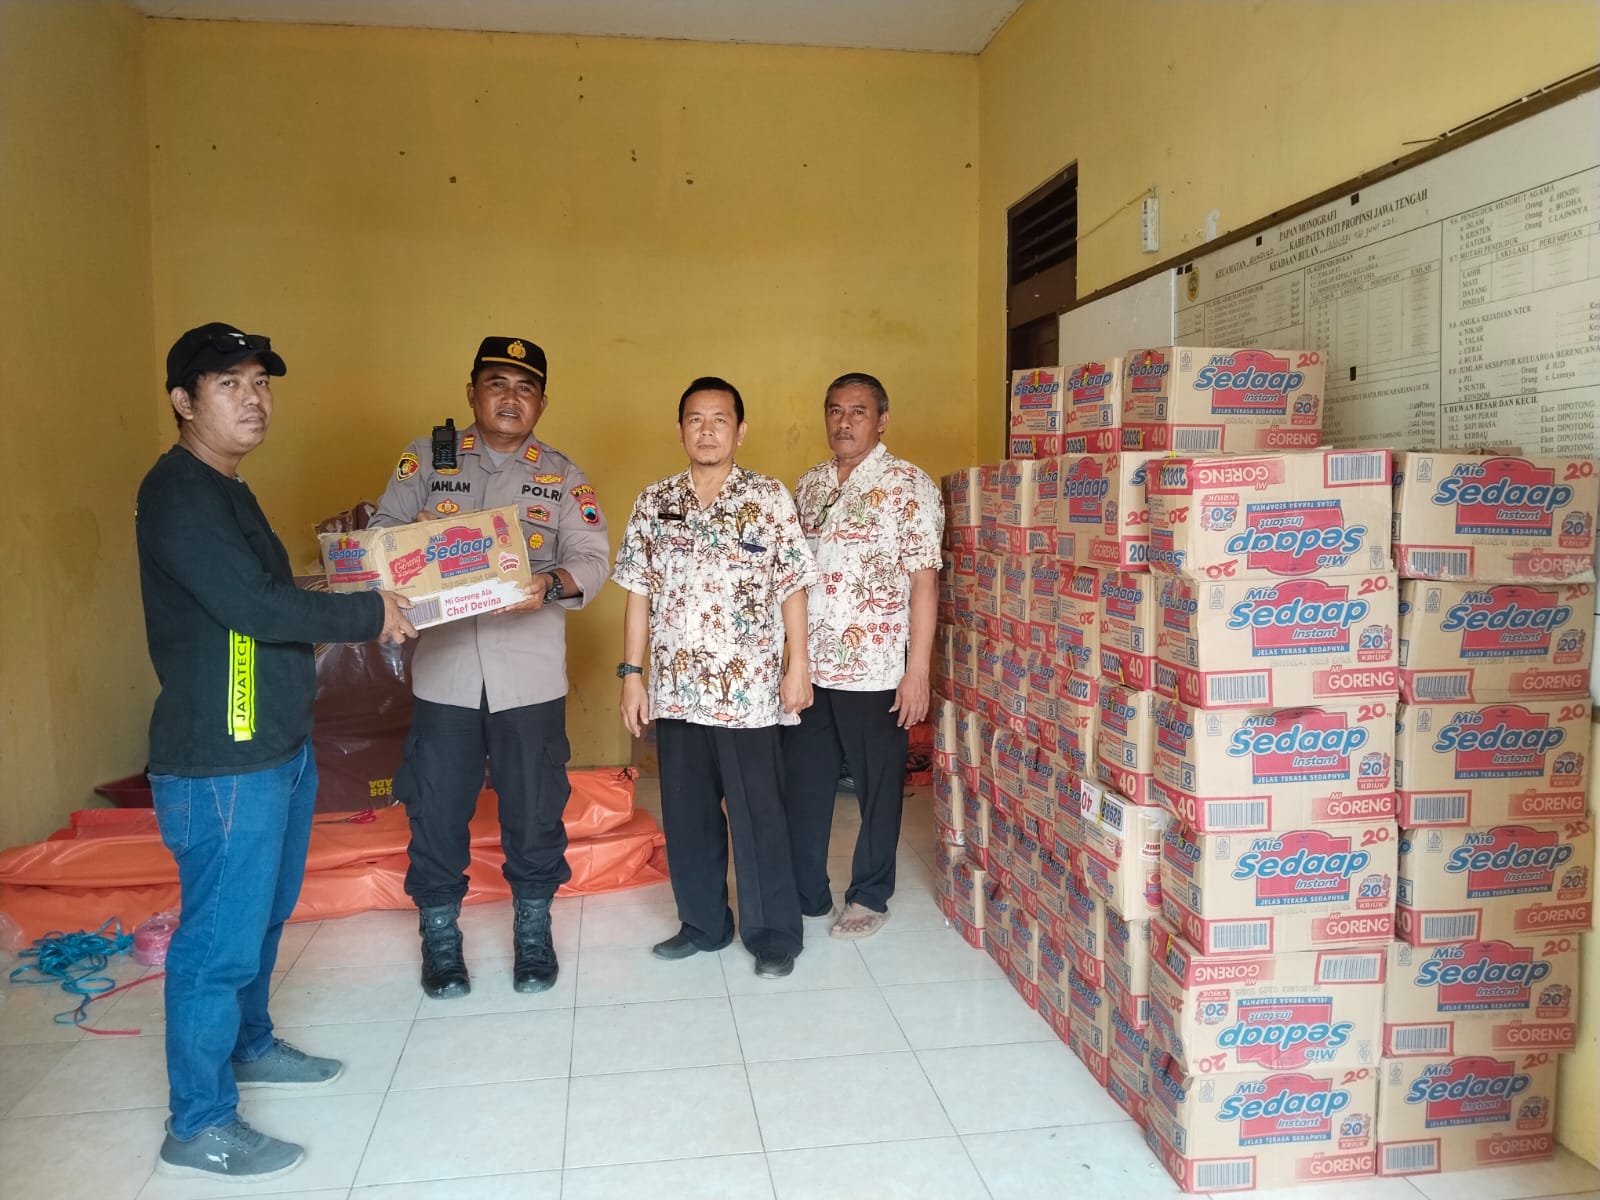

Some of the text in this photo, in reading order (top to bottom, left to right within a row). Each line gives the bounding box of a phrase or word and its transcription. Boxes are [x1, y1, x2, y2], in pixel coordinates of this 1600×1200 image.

[1529, 185, 1555, 198] AGAMA
[1289, 227, 1325, 249] KABUPATEN
[1326, 224, 1340, 238] PATI
[1341, 211, 1372, 232] PROPINSI
[1373, 203, 1393, 218] JAWA
[1395, 188, 1428, 211] TENGAH
[1554, 206, 1588, 222] LAINNYA
[1280, 210, 1337, 241] PAPAN MONOGRAFI
[1215, 261, 1246, 279] KECAMATAN
[1209, 355, 1235, 367] Mie
[1297, 352, 1319, 368] 20
[1128, 362, 1169, 377] Sedaap
[1067, 372, 1113, 390] Sedaap
[1193, 365, 1304, 392] Sedaap
[1015, 382, 1059, 397] Sedaap
[1243, 393, 1280, 402] Instant
[1451, 397, 1538, 413] HEWAN BESAR DAN KECIL
[1558, 401, 1594, 410] DIPOTONG
[1558, 412, 1594, 421] DIPOTONG
[1557, 422, 1594, 432] DIPOTONG
[1043, 437, 1057, 452] 40
[1097, 434, 1112, 448] 40
[1152, 430, 1165, 445] 40
[1267, 430, 1317, 446] GORENG
[1557, 433, 1594, 442] DIPOTONG
[1557, 444, 1594, 452] DIPOTONG
[1199, 466, 1269, 484] GORENG
[1453, 464, 1485, 477] Mie
[1564, 462, 1593, 480] 20
[1064, 476, 1108, 500] Sedaap
[1432, 477, 1573, 513] Sedaap
[1258, 516, 1303, 529] Instant
[1496, 509, 1540, 520] Instant
[425, 537, 493, 563] Sedaap
[1225, 527, 1366, 557] Sedaap
[328, 548, 366, 560] Sedaap
[1093, 544, 1118, 558] GORENG
[395, 556, 421, 574] Goreng
[1317, 554, 1349, 566] Mie
[1528, 558, 1591, 572] GORENG
[1206, 559, 1239, 578] 20
[1101, 582, 1143, 603] Sedaap
[1357, 576, 1388, 595] 20
[1566, 584, 1590, 601] 20
[445, 589, 492, 606] Mi Goreng Ala
[1159, 592, 1198, 613] Sedaap
[1246, 588, 1278, 601] Mie
[1463, 592, 1493, 604] Mie
[447, 597, 502, 617] Chef Devina
[1226, 599, 1369, 630] Sedaap
[1441, 603, 1573, 632] Sedaap
[1292, 628, 1338, 639] Instant
[1499, 632, 1540, 643] Instant
[1129, 657, 1143, 677] 40
[237, 634, 247, 721] JAVATECH
[1186, 674, 1199, 695] 40
[1328, 673, 1394, 689] GORENG
[1522, 675, 1582, 689] GORENG
[1356, 703, 1386, 723] 20
[1452, 712, 1483, 725] Mie
[1557, 704, 1585, 723] 20
[1156, 710, 1193, 740] Sedaap
[1244, 716, 1276, 728] Mie
[1227, 725, 1368, 757] Sedaap
[1433, 724, 1566, 753] Sedaap
[1292, 756, 1338, 767] Instant
[1493, 754, 1535, 763] Instant
[1119, 775, 1137, 794] 40
[1081, 793, 1092, 809] 40
[1178, 797, 1196, 820] 40
[1327, 798, 1391, 816] GORENG
[1522, 797, 1582, 811] GORENG
[1360, 828, 1389, 846] 20
[1565, 822, 1589, 840] 20
[1252, 839, 1283, 852] Mie
[1464, 833, 1494, 846] Mie
[1231, 850, 1370, 880] Sedaap
[1445, 843, 1574, 873] Sedaap
[1295, 878, 1338, 890] Instant
[1504, 871, 1544, 882] Instant
[1527, 908, 1586, 923] GORENG
[1187, 916, 1201, 937] 40
[1326, 918, 1389, 936] GORENG
[1432, 947, 1464, 959] Mie
[1542, 939, 1570, 956] 20
[1081, 959, 1095, 976] 40
[1195, 965, 1260, 981] GORENG
[1414, 959, 1551, 986] Sedaap
[1476, 986, 1519, 997] Instant
[1249, 1010, 1292, 1021] Instant
[1112, 1012, 1149, 1050] Sedaap
[1218, 1021, 1352, 1049] Sedaap
[1507, 1028, 1571, 1042] GORENG
[1199, 1053, 1227, 1071] 20
[1305, 1049, 1336, 1062] Mie
[1522, 1054, 1548, 1069] 20
[1089, 1056, 1101, 1074] 40
[1423, 1065, 1452, 1076] Mie
[1341, 1068, 1369, 1085] 20
[1236, 1082, 1266, 1094] Mie
[1405, 1074, 1531, 1104] Sedaap
[1218, 1090, 1350, 1121] Sedaap
[1277, 1118, 1320, 1128] Instant
[1489, 1138, 1548, 1155] GORENG
[1169, 1158, 1185, 1180] 40
[1310, 1157, 1372, 1175] GORENG
